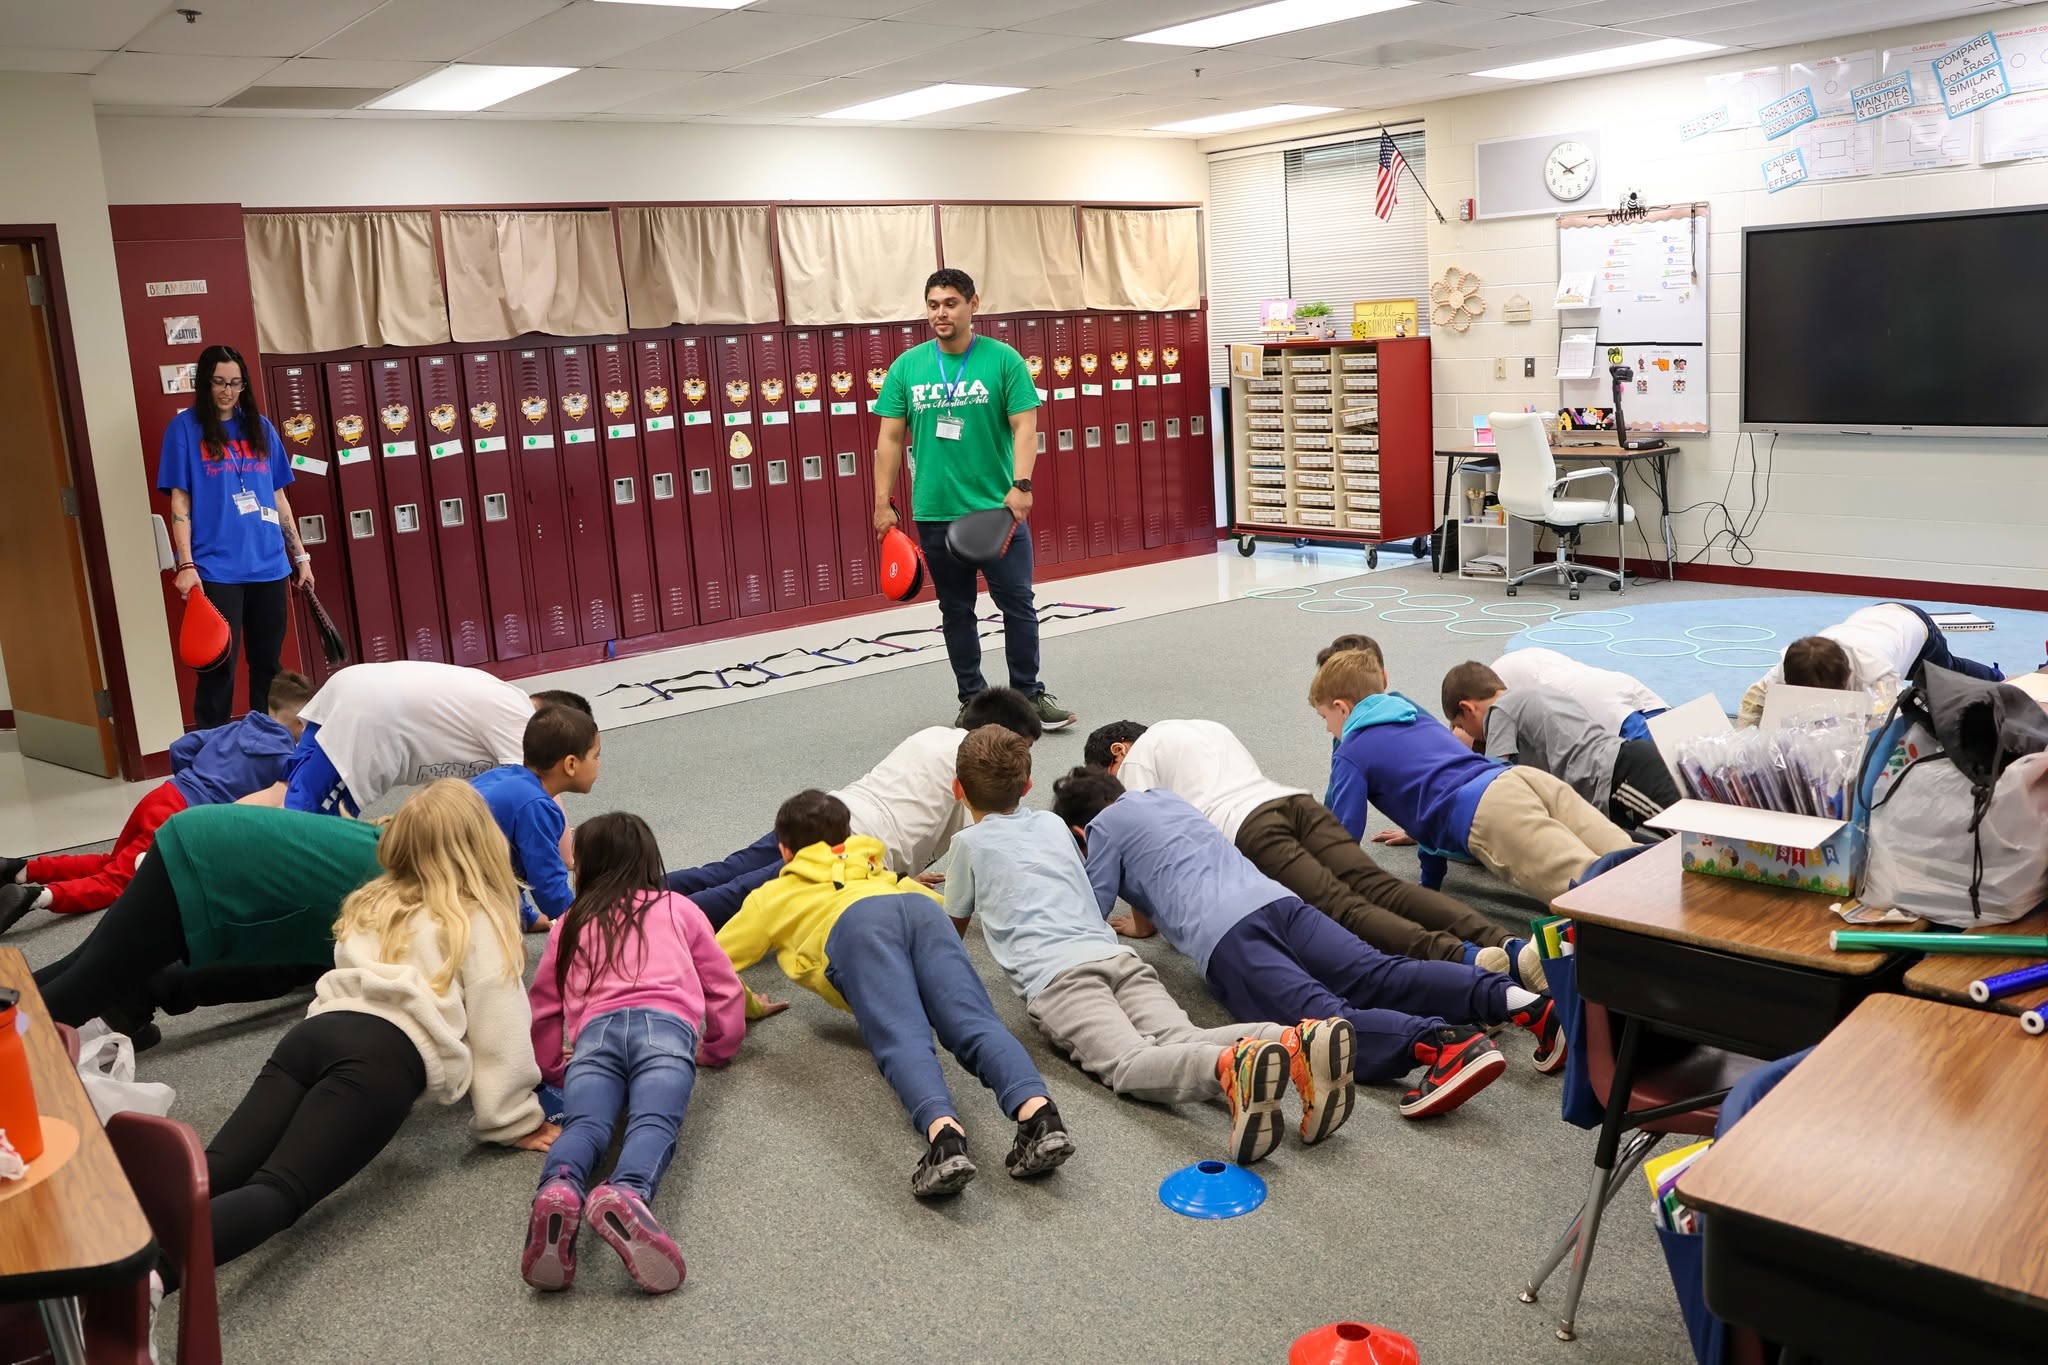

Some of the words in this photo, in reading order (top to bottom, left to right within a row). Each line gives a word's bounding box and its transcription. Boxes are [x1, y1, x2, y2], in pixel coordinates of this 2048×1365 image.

[1936, 35, 1990, 70] COMPARE
[1962, 57, 1970, 66] &
[1942, 52, 1995, 86] CONTRAST
[1853, 75, 1906, 98] CATEGORIES
[1948, 68, 1997, 96] SIMILAR
[1761, 99, 1791, 123] CHARACTER
[1788, 90, 1808, 108] TRAITS
[1856, 94, 1882, 110] MAIN
[1883, 86, 1909, 101] IDEA
[1858, 110, 1865, 118] &
[1867, 94, 1910, 116] DETAILS
[1949, 83, 2005, 114] DIFFERENT
[1765, 114, 1794, 136] DESCRIBING
[1793, 105, 1813, 121] WORDS
[1766, 152, 1797, 172] CAUSE
[1781, 166, 1787, 175] &
[1768, 168, 1803, 190] EFFECT
[910, 379, 989, 403] RTMA
[912, 401, 931, 414] Tiger
[932, 396, 968, 409] Martial
[1753, 842, 1835, 861] ASTER
